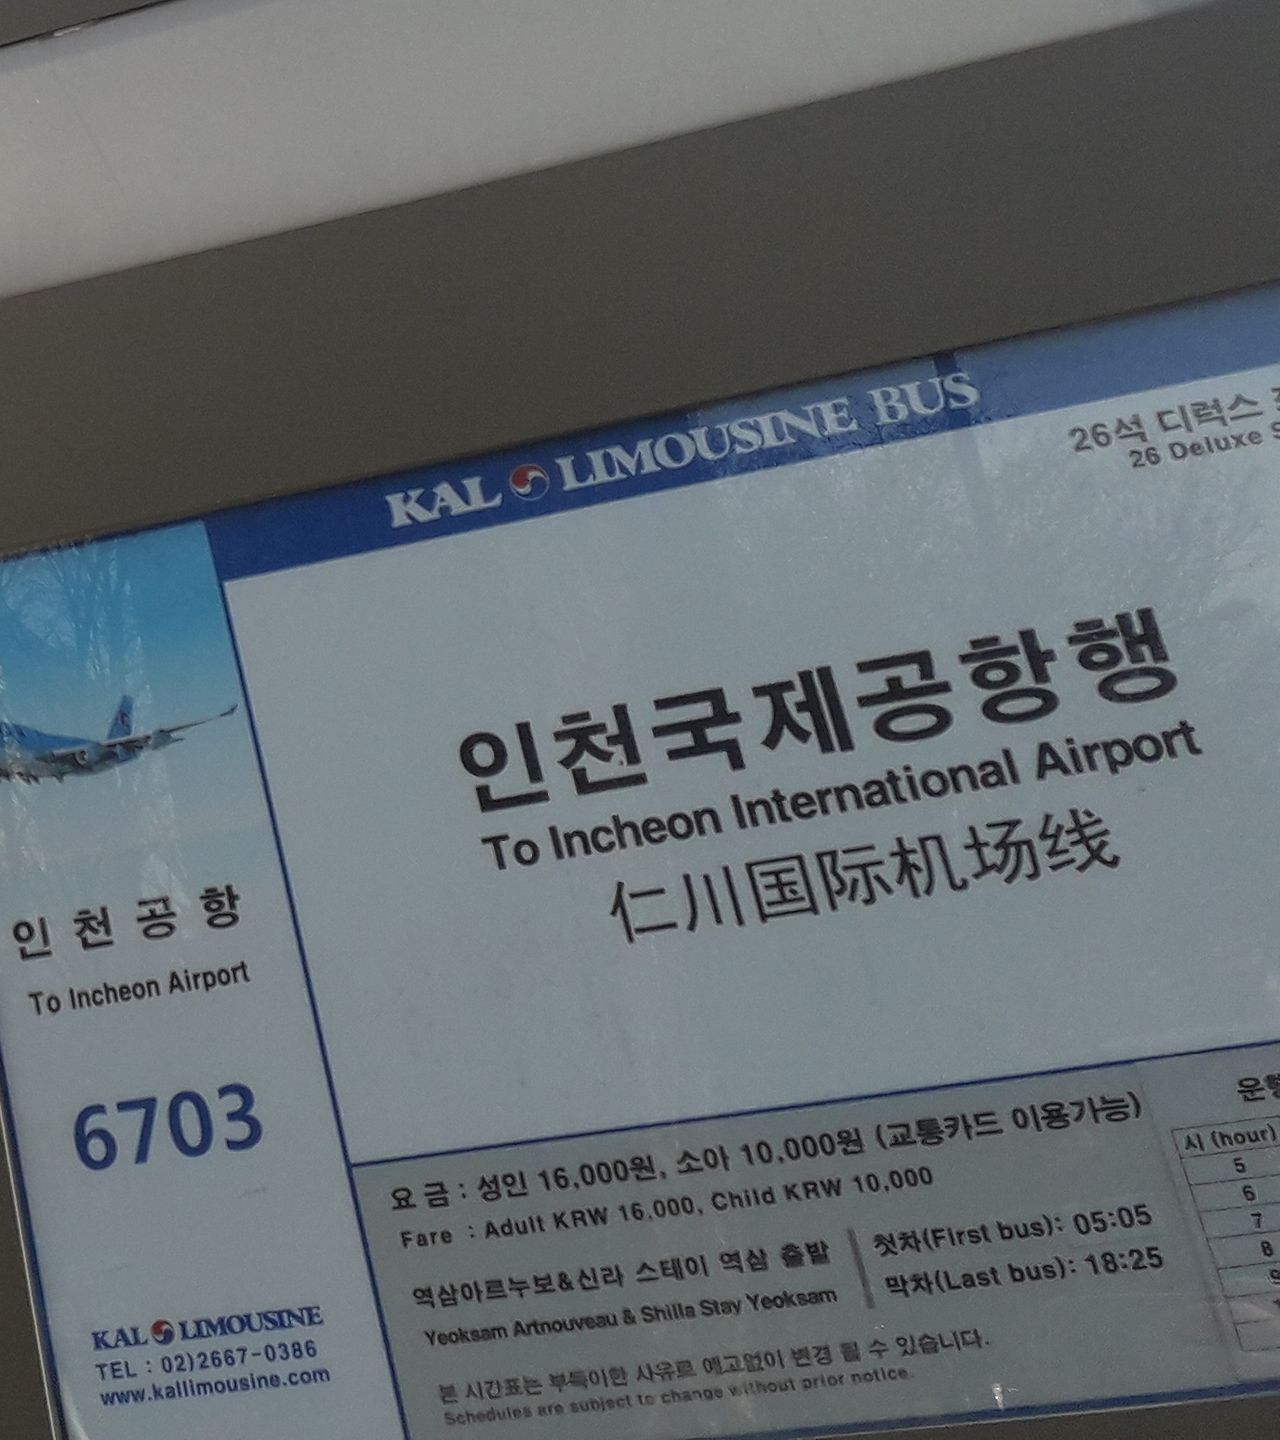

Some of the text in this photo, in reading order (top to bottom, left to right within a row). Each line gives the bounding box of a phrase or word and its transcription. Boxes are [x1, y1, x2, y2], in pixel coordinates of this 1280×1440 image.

[1070, 414, 1148, 452] 26석
[1156, 393, 1264, 433] 디럭스
[384, 370, 982, 530] KAL LIMOUSINE BUS
[1129, 447, 1161, 469] 26
[1169, 429, 1264, 460] Deluxe
[457, 606, 1180, 813] 인천국제공항행
[480, 718, 1203, 872] To Incheon International Airport
[608, 806, 1121, 944] 仁川国际机场线
[28, 960, 251, 1017] To Incheon Airport
[73, 1082, 264, 1172] 6703
[1211, 1123, 1277, 1149] (hour)
[478, 1170, 529, 1202] 성인
[676, 1145, 731, 1174] 소아
[1233, 1157, 1246, 1173] 5
[400, 1229, 453, 1249] Fare
[485, 1215, 546, 1240] Adult
[552, 1206, 608, 1230] KRW
[710, 1186, 776, 1211] Child
[783, 1177, 842, 1202] KRW
[853, 1166, 934, 1194] 10,000
[1242, 1185, 1256, 1202] 6
[1072, 1204, 1153, 1236] 05:05
[1250, 1212, 1262, 1229] 7
[636, 1254, 710, 1283] 스테이
[719, 1248, 770, 1273] 역삼
[1083, 1246, 1164, 1277] 18:25
[1260, 1240, 1274, 1257] 8
[91, 1305, 325, 1351] KAL LIMOUSINE
[424, 1289, 839, 1347] Yeoksam Artnouveau & Shilla Stay Yeoksam
[95, 1360, 138, 1382] TEL
[161, 1339, 319, 1375] 02)2667-0386
[868, 1339, 889, 1358] 수
[100, 1366, 331, 1406] www.kallimousine.com
[443, 1402, 533, 1427] Schedules
